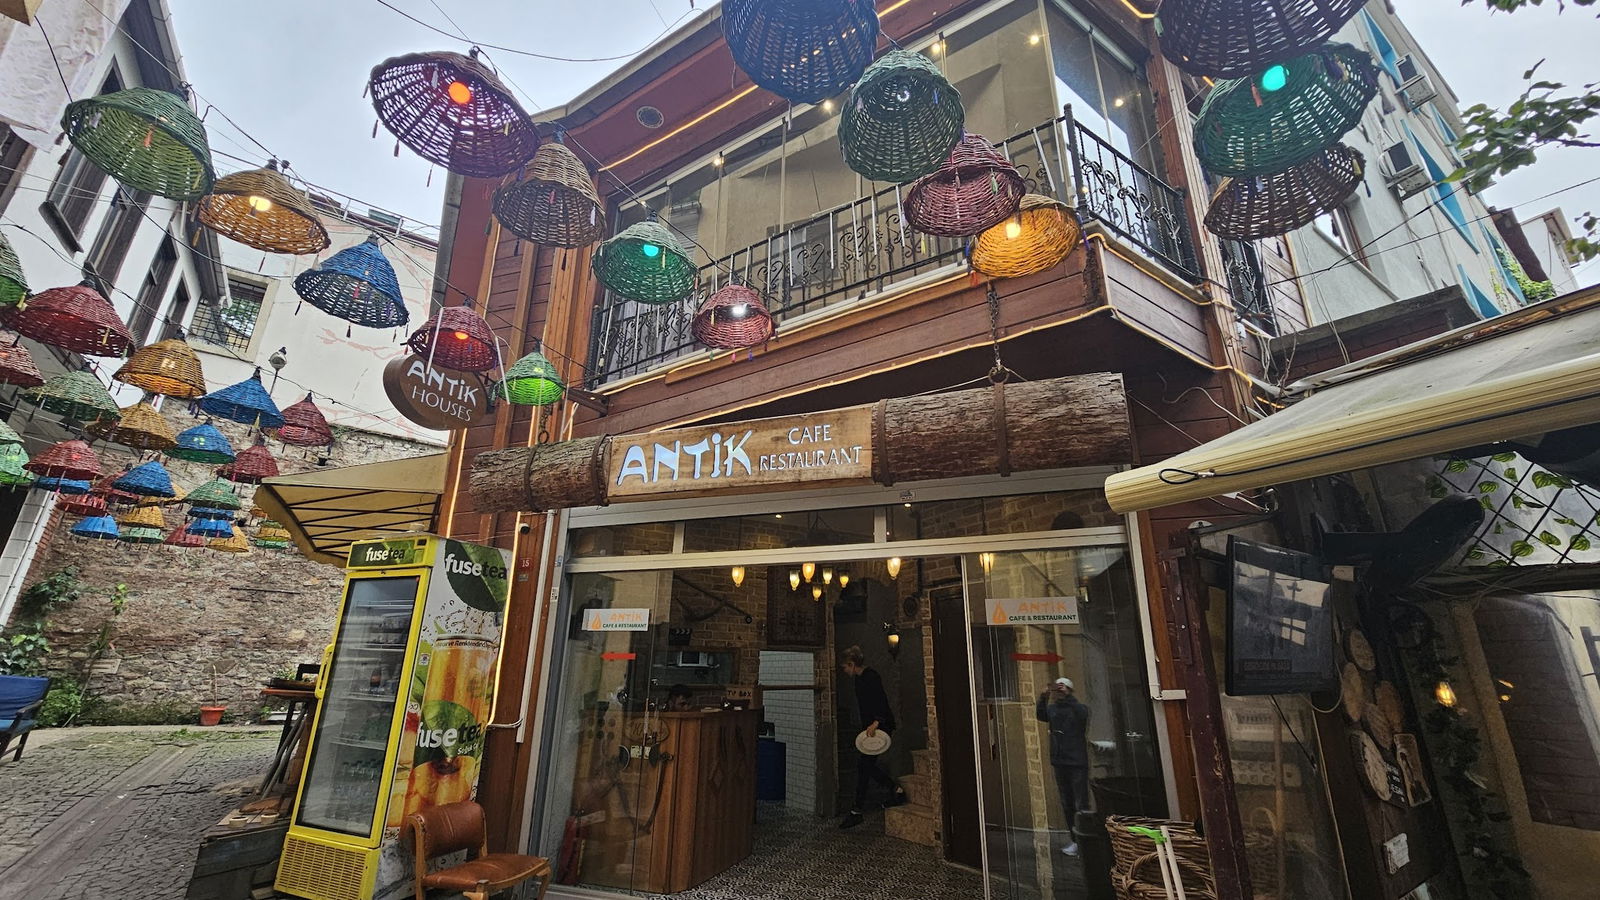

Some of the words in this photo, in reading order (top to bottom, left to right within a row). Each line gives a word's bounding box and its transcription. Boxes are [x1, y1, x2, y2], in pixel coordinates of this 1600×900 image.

[412, 385, 472, 422] HOUSES
[788, 424, 832, 446] CAFE
[759, 446, 863, 472] RESTAURANT
[521, 559, 530, 567] 15
